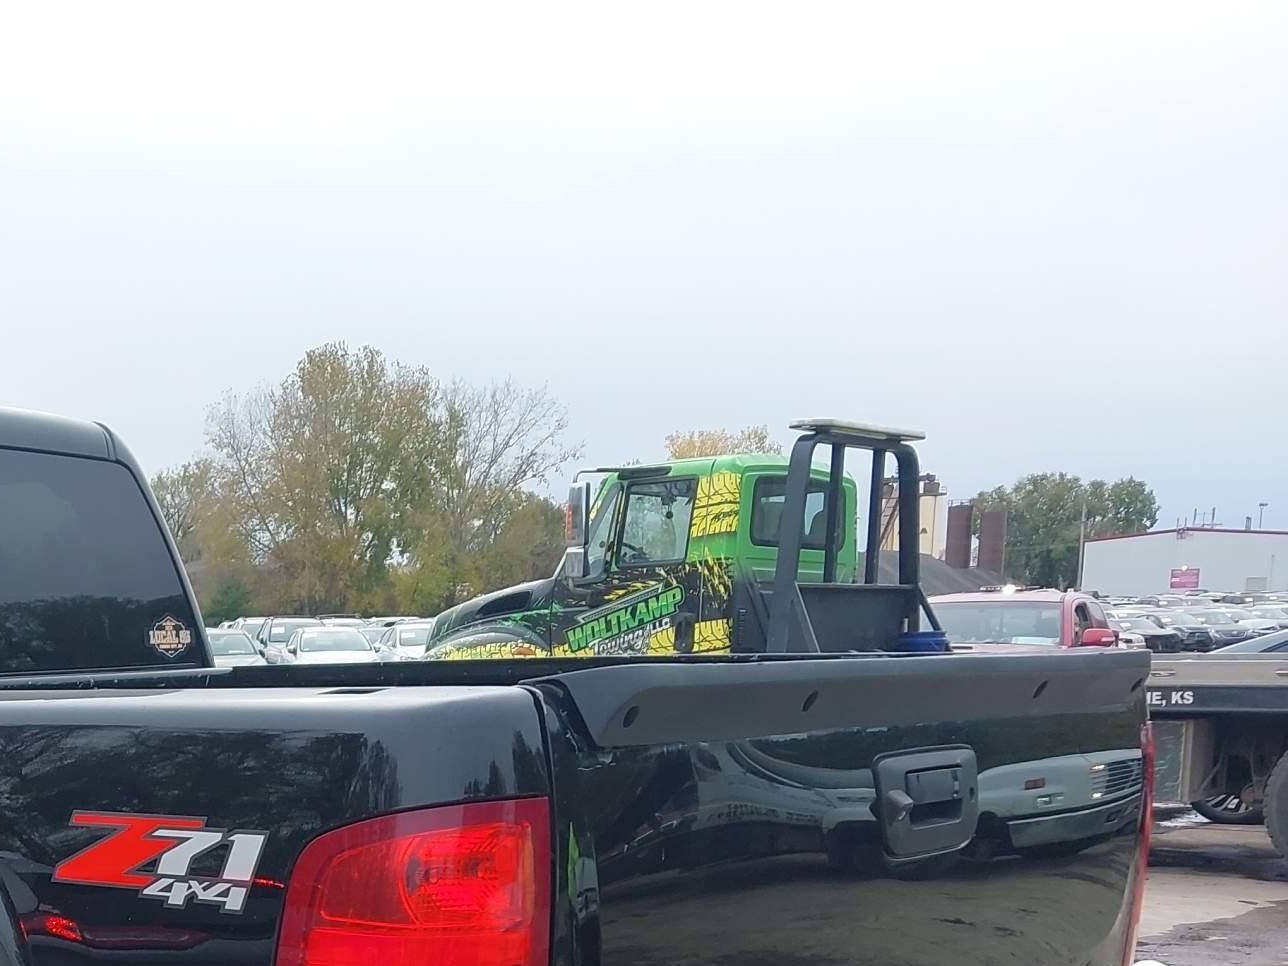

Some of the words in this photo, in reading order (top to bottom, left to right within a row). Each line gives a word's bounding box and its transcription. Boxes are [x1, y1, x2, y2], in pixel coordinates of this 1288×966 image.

[567, 587, 682, 652] WOLTKAMP
[589, 629, 645, 654] Towing
[1171, 691, 1194, 704] KS
[51, 810, 269, 889] Z71
